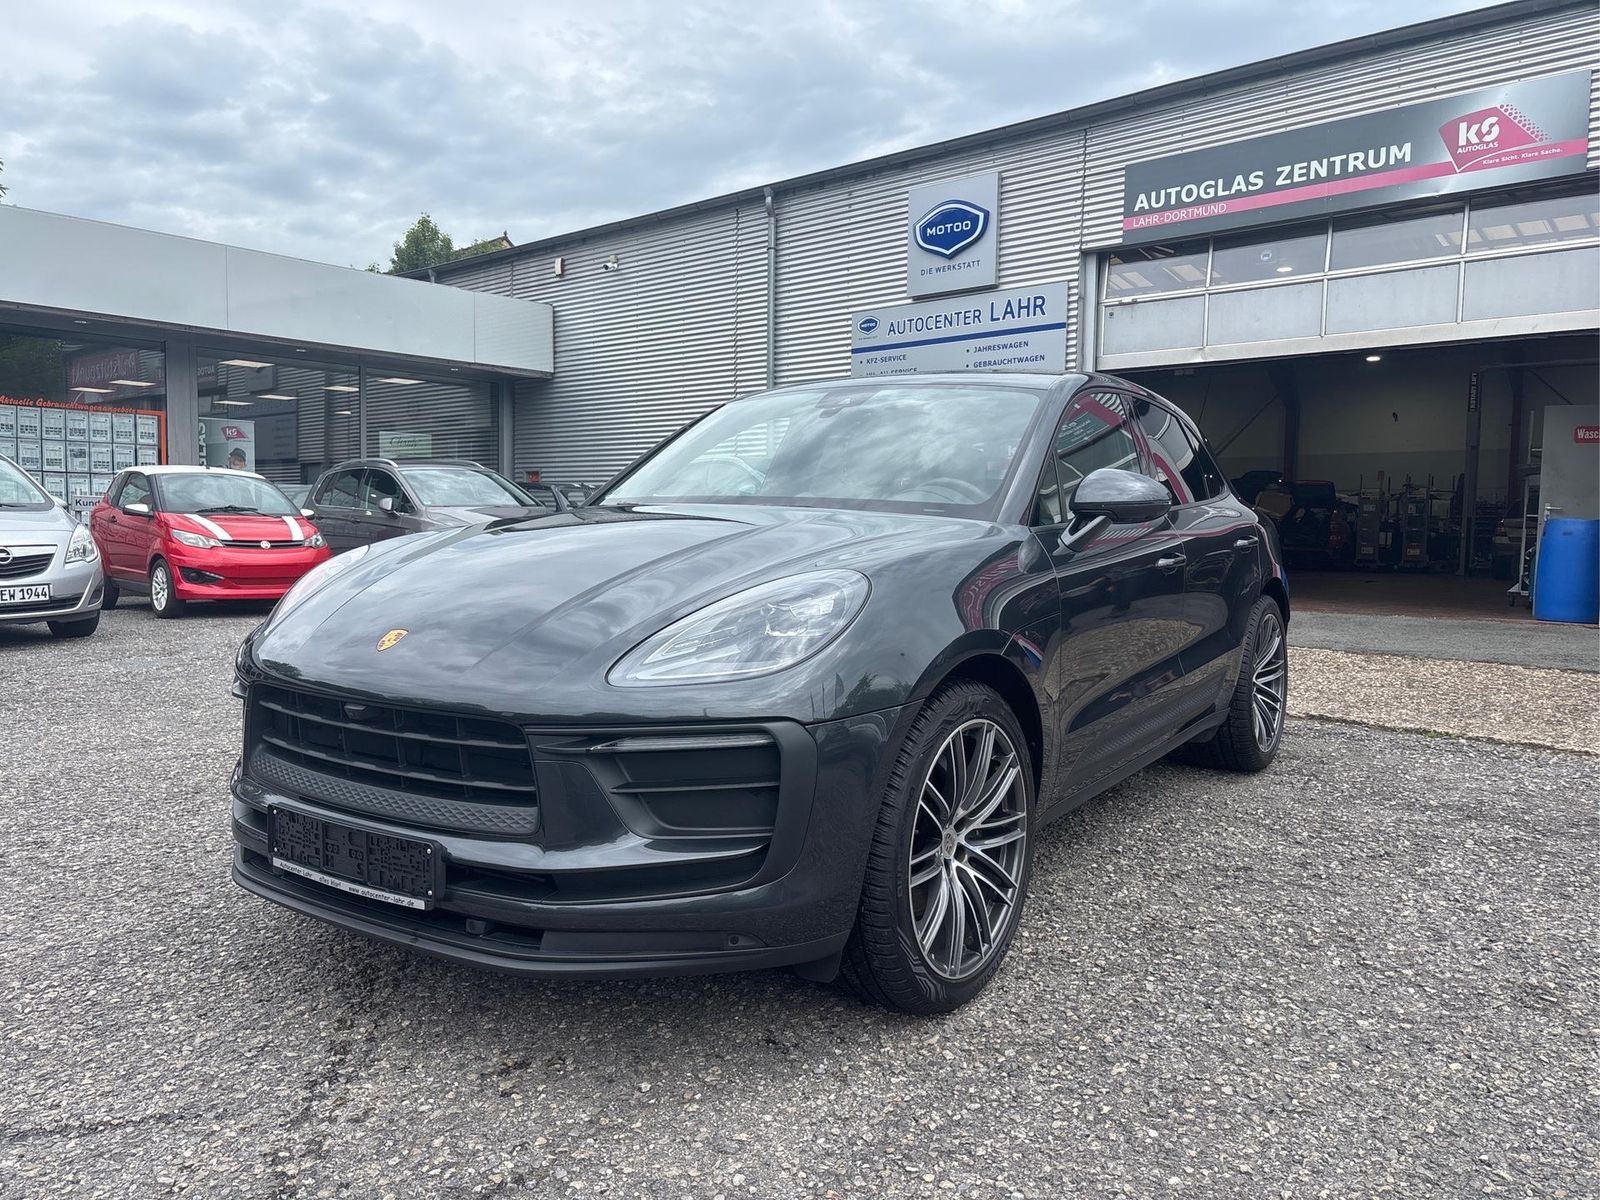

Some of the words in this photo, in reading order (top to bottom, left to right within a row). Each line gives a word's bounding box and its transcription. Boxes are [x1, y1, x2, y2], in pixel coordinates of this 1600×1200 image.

[1456, 141, 1499, 154] AUTOGLAS
[1482, 157, 1500, 165] Klare
[1500, 154, 1520, 162] Sicht.
[1521, 151, 1538, 159] Klare
[1540, 148, 1563, 156] Sache.
[1133, 170, 1264, 213] AUTOGLAS
[1275, 141, 1412, 186] ZENTRUM
[1132, 203, 1228, 228] LAHR-DORTMUND
[926, 220, 971, 237] MOTOO
[920, 267, 933, 276] DIE
[935, 260, 981, 274] WERKSTATT
[887, 308, 982, 337] AUTOCENTER
[990, 295, 1046, 322] LAHR
[973, 340, 1029, 354] JAHRESWAGEN
[866, 354, 907, 365] KFZ-SERVICE
[973, 354, 1046, 369] GEBRAUCHTWAGEN
[0, 395, 34, 407] Aktuelle
[0, 588, 16, 601] EW
[19, 587, 48, 600] 1944
